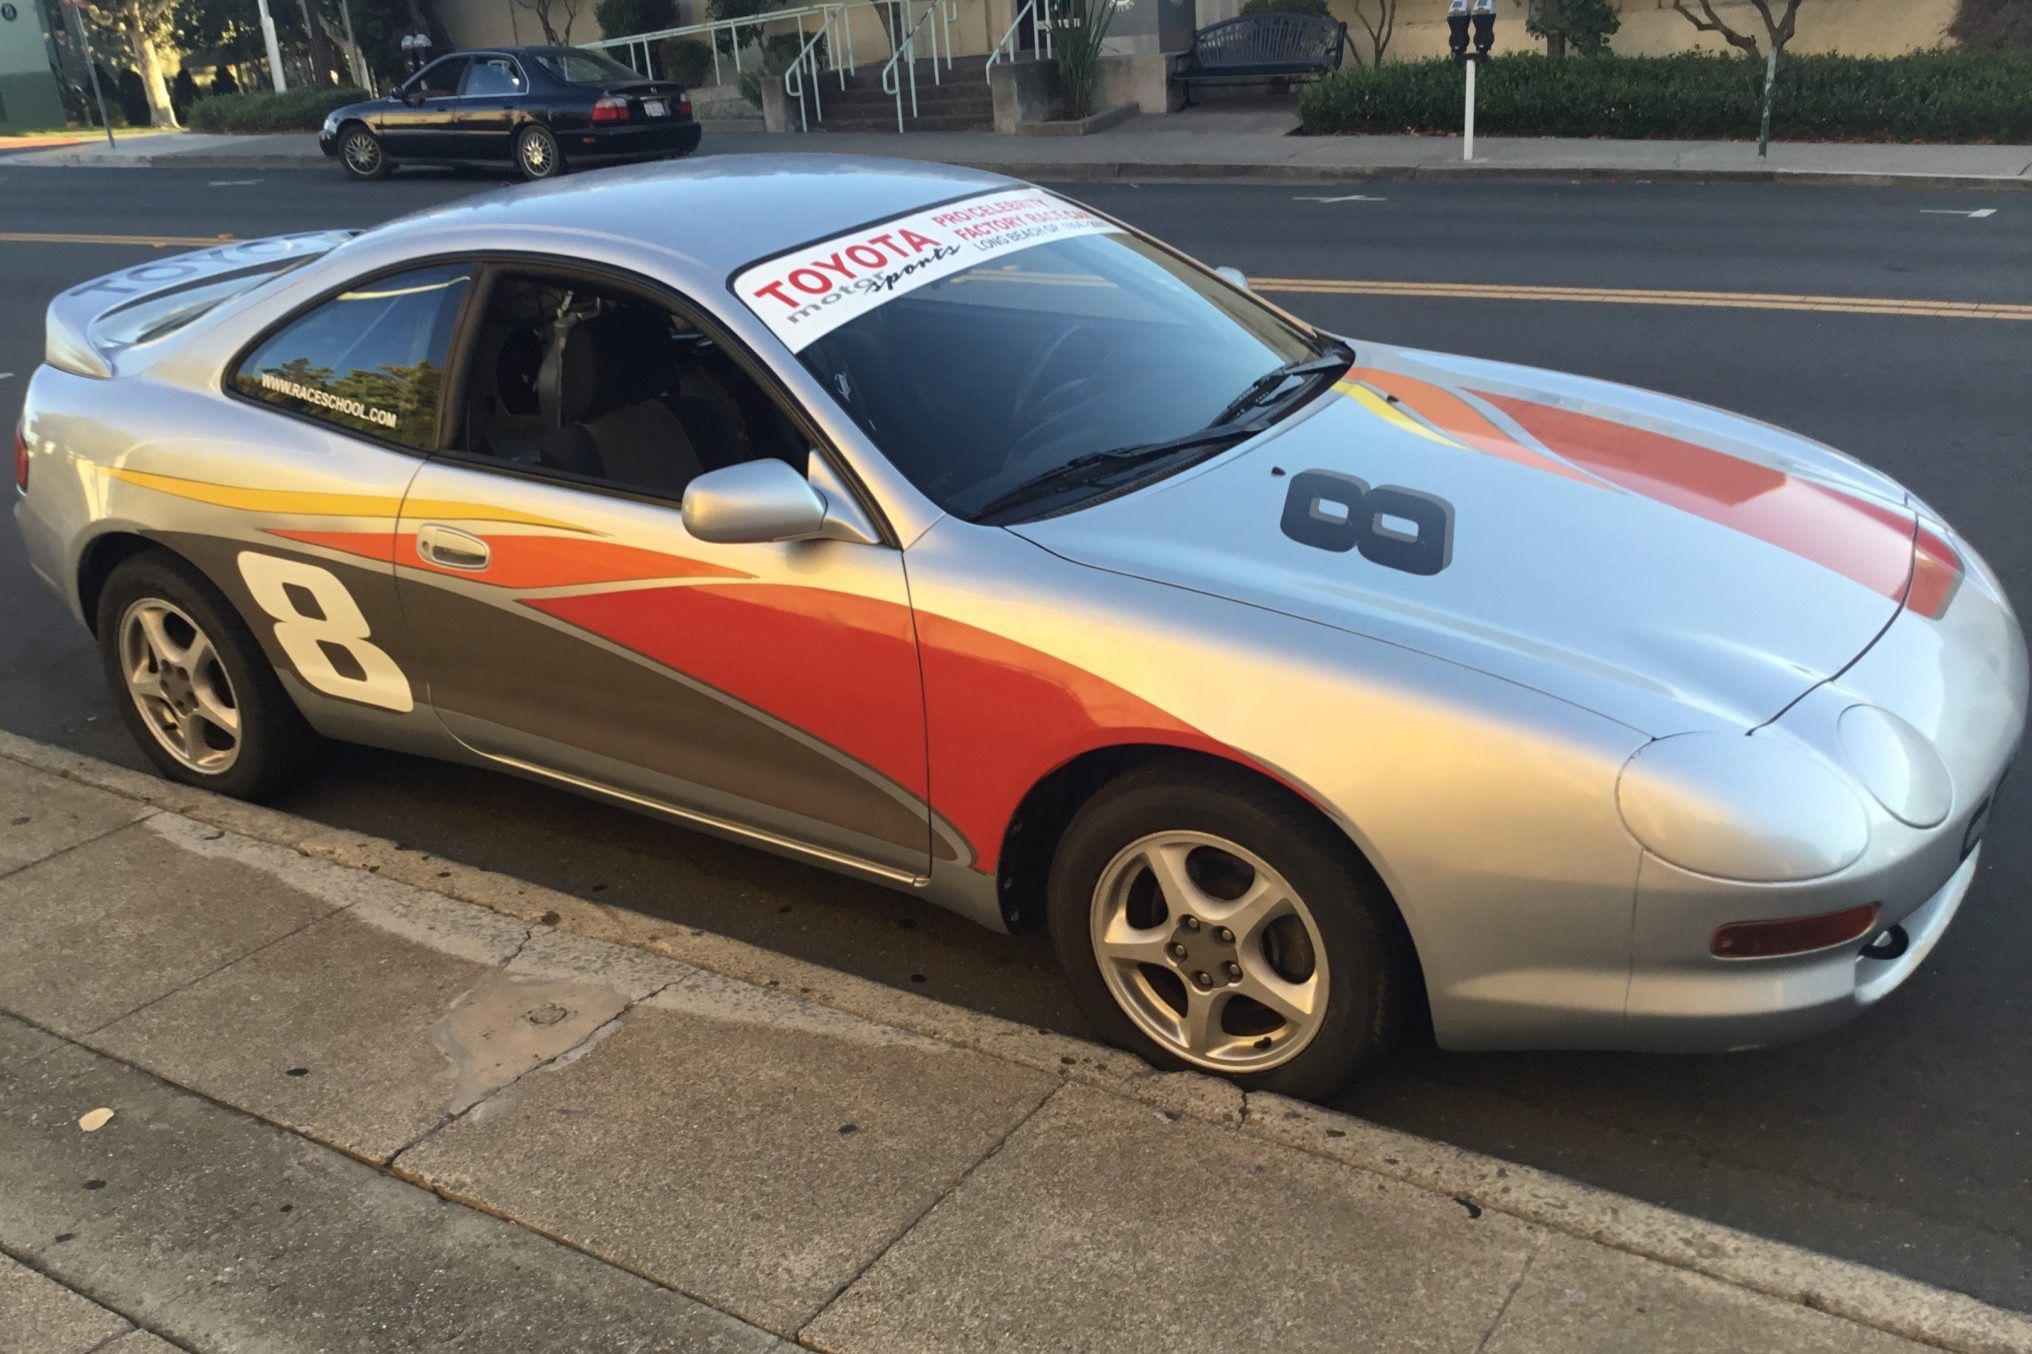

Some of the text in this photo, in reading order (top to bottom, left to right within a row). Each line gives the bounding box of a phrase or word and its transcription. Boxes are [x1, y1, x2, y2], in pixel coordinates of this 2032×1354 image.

[931, 198, 1049, 228] PRO/CELEBRITY
[953, 214, 1028, 241] FACTORY
[1025, 209, 1061, 225] RACE
[973, 233, 1010, 252] LONG
[1005, 225, 1045, 243] BEACH
[753, 227, 942, 309] TOYOTA
[786, 244, 961, 324] motor sports
[261, 372, 398, 429] WWW.RACESCHOOL.COM
[1279, 467, 1456, 577] 8
[236, 550, 415, 714] 8
